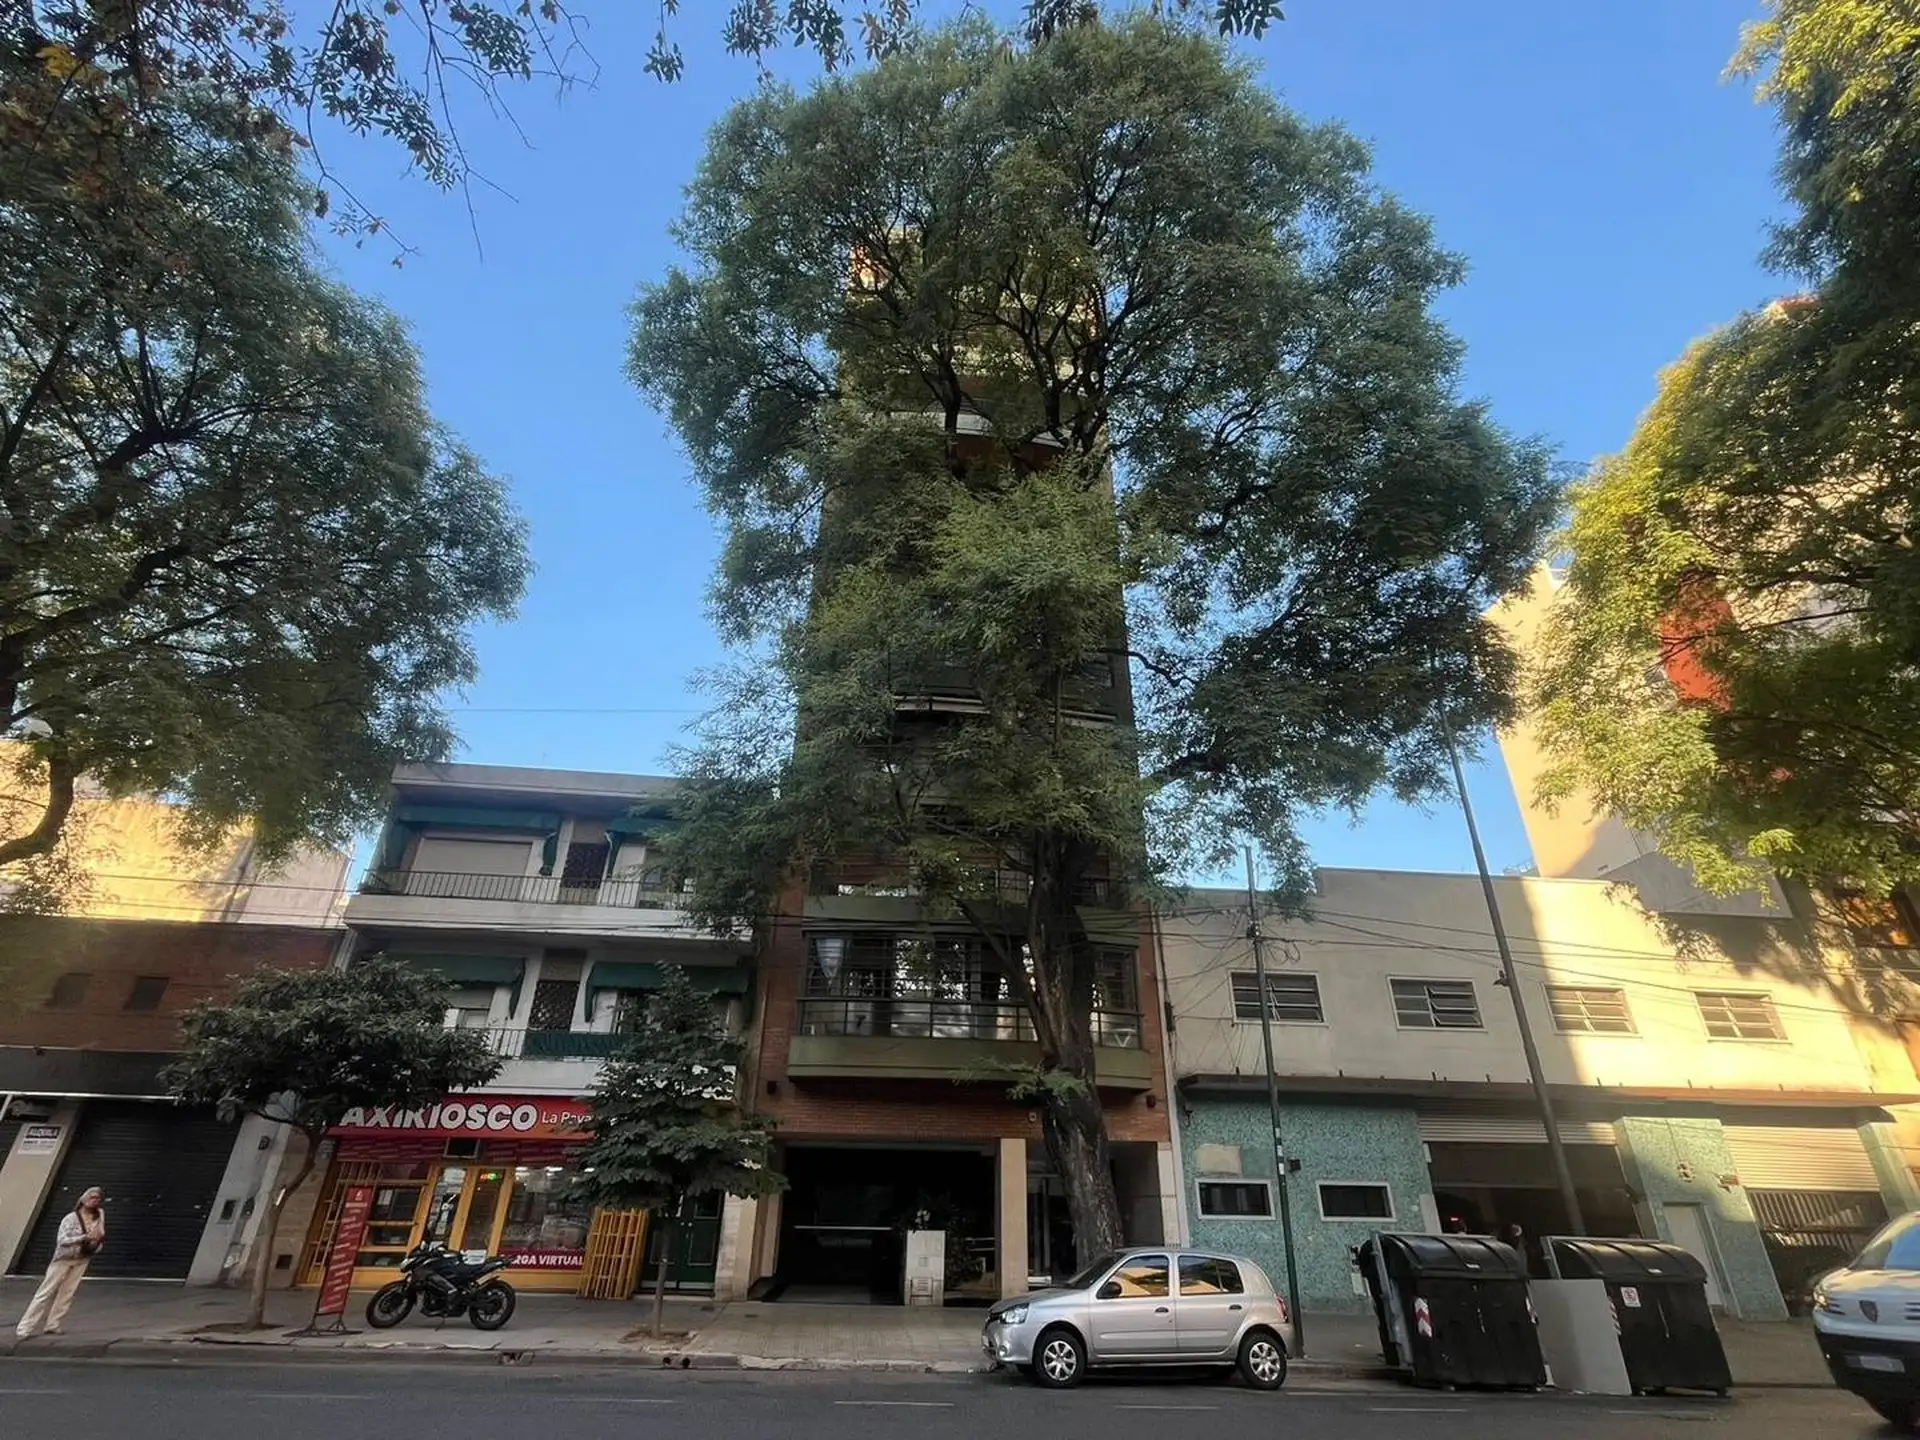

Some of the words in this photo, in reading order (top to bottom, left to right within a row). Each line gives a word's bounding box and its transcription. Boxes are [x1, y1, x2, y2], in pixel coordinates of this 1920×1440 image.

[338, 1103, 537, 1130] AXIKIOSCO
[541, 1112, 558, 1124] La
[506, 1254, 536, 1266] RGA
[538, 1254, 583, 1266] VIRTUAL
